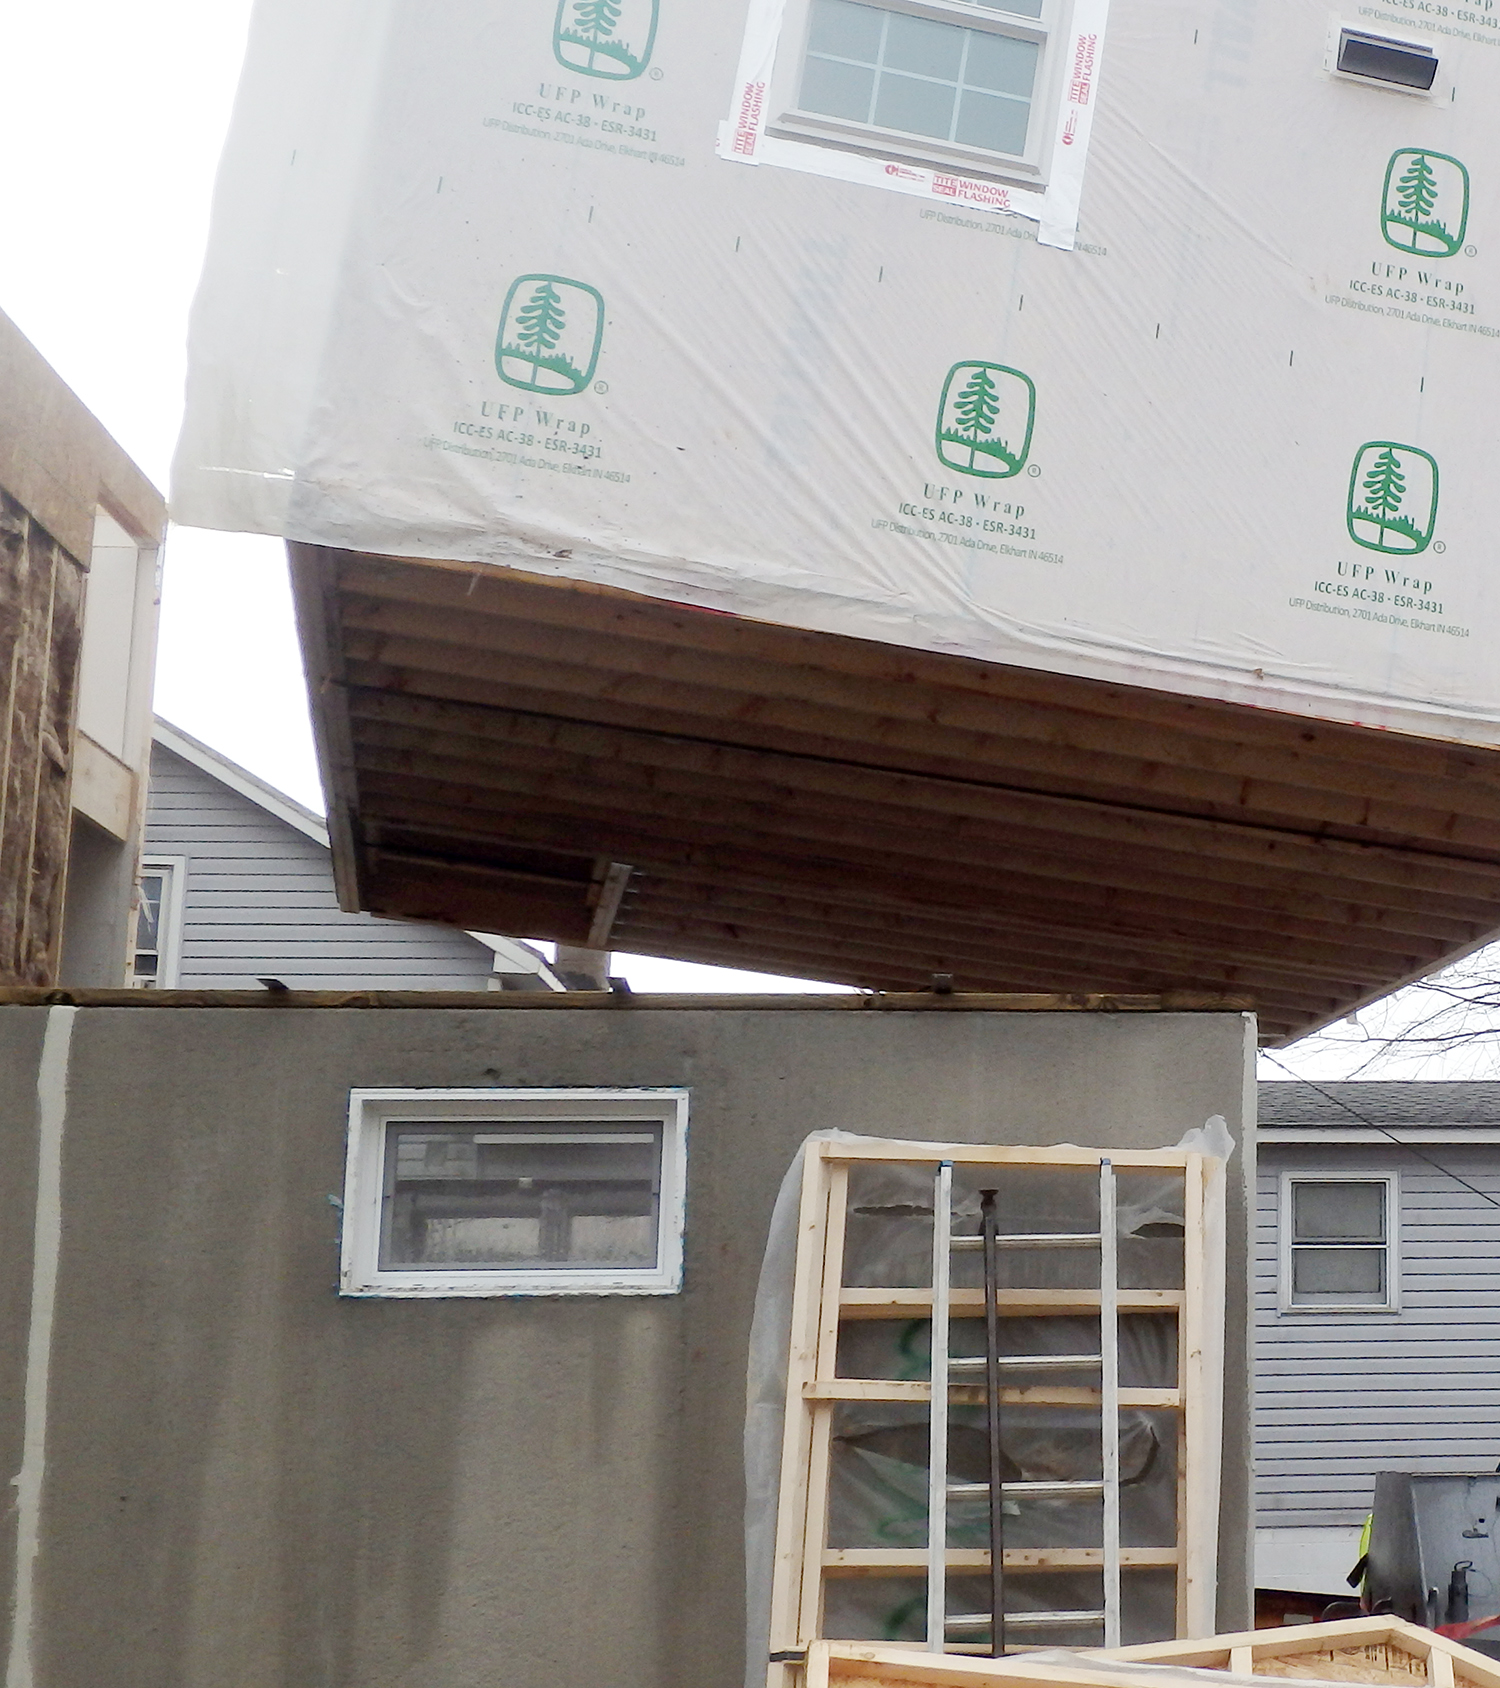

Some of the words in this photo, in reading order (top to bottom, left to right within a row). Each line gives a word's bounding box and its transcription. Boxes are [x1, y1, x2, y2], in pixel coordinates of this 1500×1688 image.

[1418, 1, 1448, 17] AC-38
[1073, 34, 1086, 79] WINDOW
[1082, 34, 1097, 81] FLASHING
[539, 82, 581, 103] UFP
[593, 93, 646, 121] Wrap
[738, 82, 754, 129] WINDOW
[748, 82, 765, 131] FLASHING
[512, 102, 551, 119] ICC-ES
[554, 111, 590, 128] AC-38
[601, 120, 657, 142] ESR-3431
[934, 175, 957, 187] TITE
[959, 180, 1009, 198] WINDOW
[958, 190, 1010, 208] FLASHING
[1371, 261, 1408, 280] UFP
[1417, 271, 1464, 295] Wrap
[1350, 280, 1383, 295] ICC-ES
[1386, 288, 1417, 303] AC-38
[1426, 295, 1475, 314] ESR-3431
[481, 401, 524, 422] UFP
[536, 410, 591, 438] Wrap
[453, 421, 493, 439] ICC-ES
[497, 430, 534, 446] AC-38
[545, 438, 601, 458] ESR-3431
[924, 483, 963, 504] UFP
[974, 493, 1025, 519] Wrap
[899, 503, 934, 520] ICC-ES
[938, 511, 973, 528] AC-38
[983, 520, 1036, 540] ESR-3431
[1337, 561, 1374, 580] UFP
[1384, 569, 1433, 594] Wrap
[1314, 581, 1349, 597] ICC-ES
[1352, 588, 1384, 603] AC-38
[1394, 595, 1443, 614] ESR-3431
